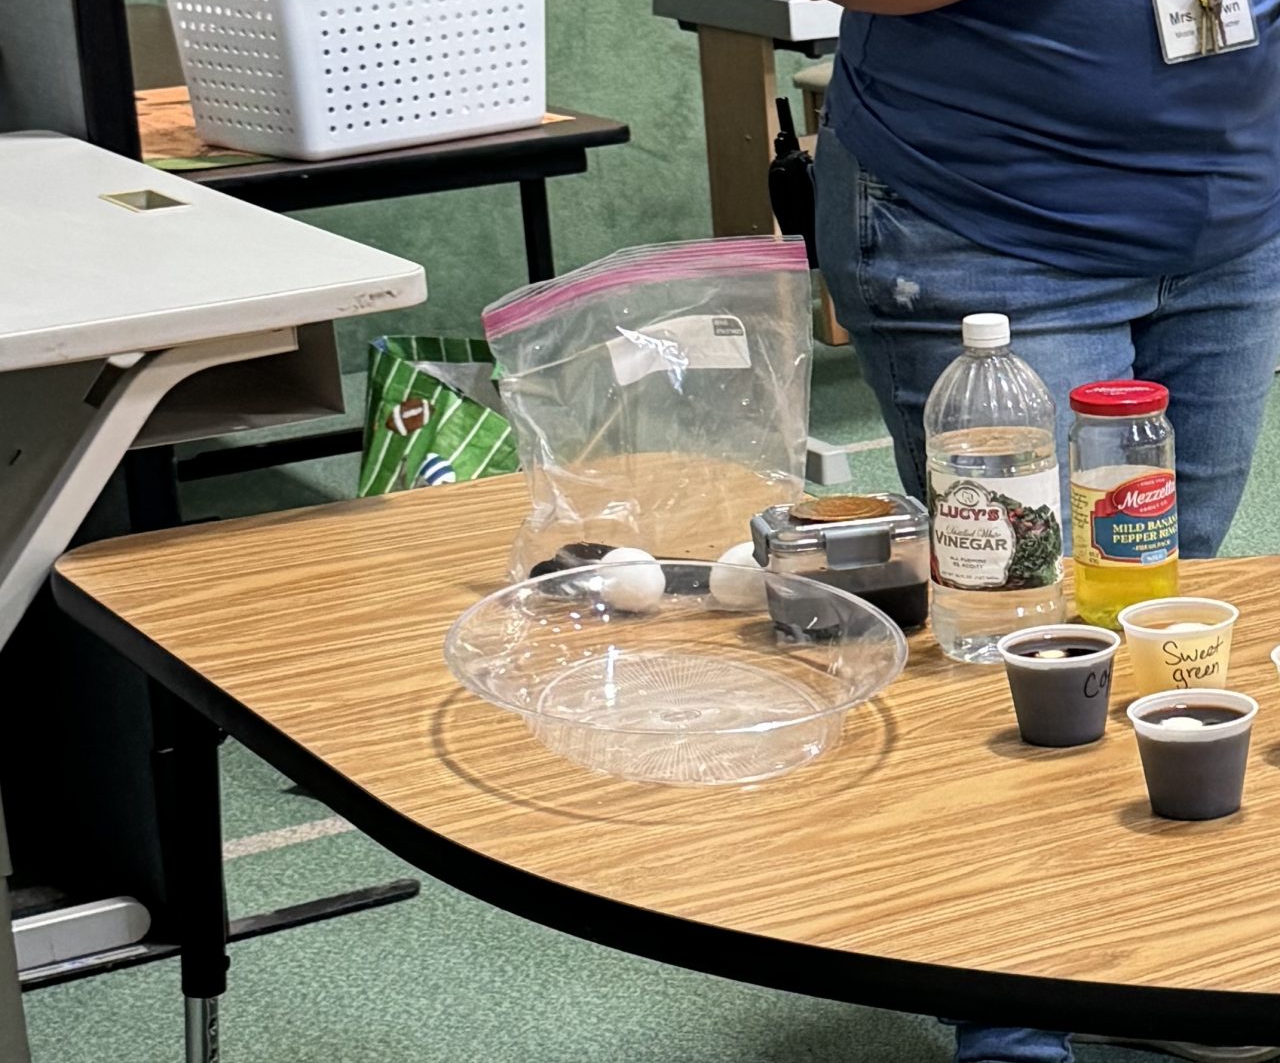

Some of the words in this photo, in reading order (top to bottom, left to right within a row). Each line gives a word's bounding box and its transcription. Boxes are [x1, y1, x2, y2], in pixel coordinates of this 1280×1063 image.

[1169, 11, 1197, 25] Mrs.
[939, 503, 1001, 522] LUCY'S
[1113, 523, 1145, 533] MILD
[1113, 531, 1157, 544] PEPPER
[935, 529, 1008, 551] VINEGAR
[1162, 635, 1224, 666] Sweet
[1172, 661, 1220, 689] green
